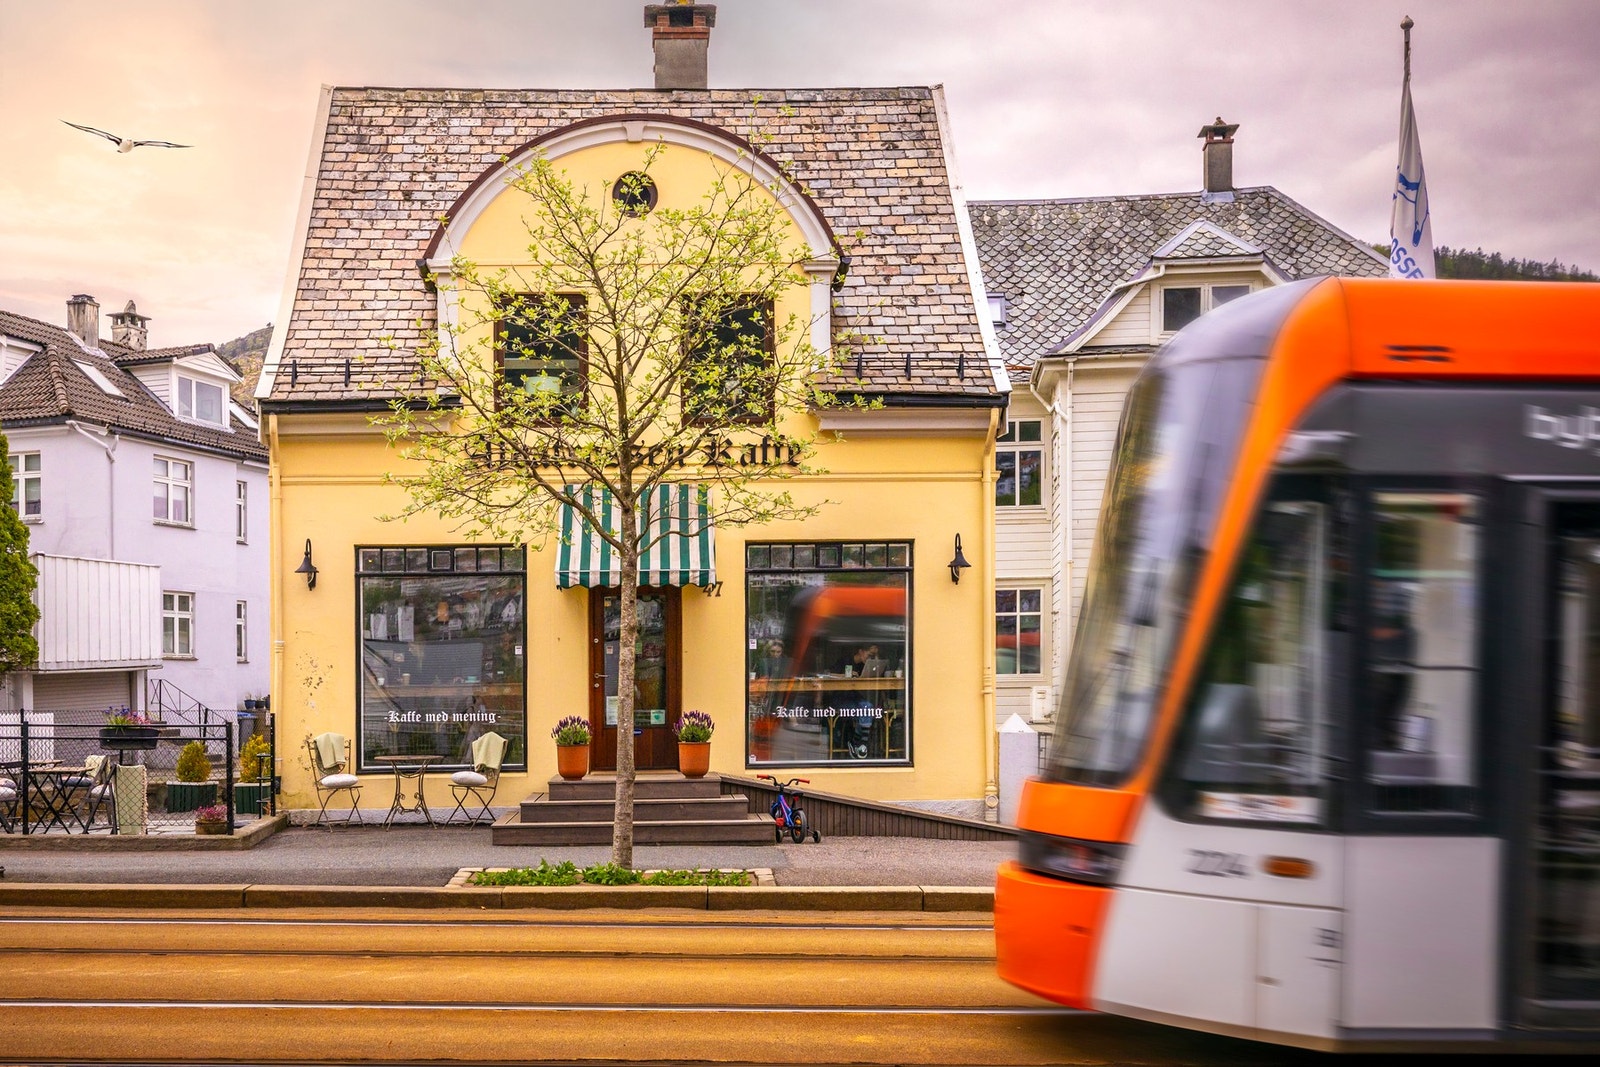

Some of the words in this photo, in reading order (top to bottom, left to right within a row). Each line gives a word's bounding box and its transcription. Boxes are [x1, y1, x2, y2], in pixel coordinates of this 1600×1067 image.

[703, 581, 723, 597] 47
[425, 711, 448, 722] med
[813, 706, 836, 718] med
